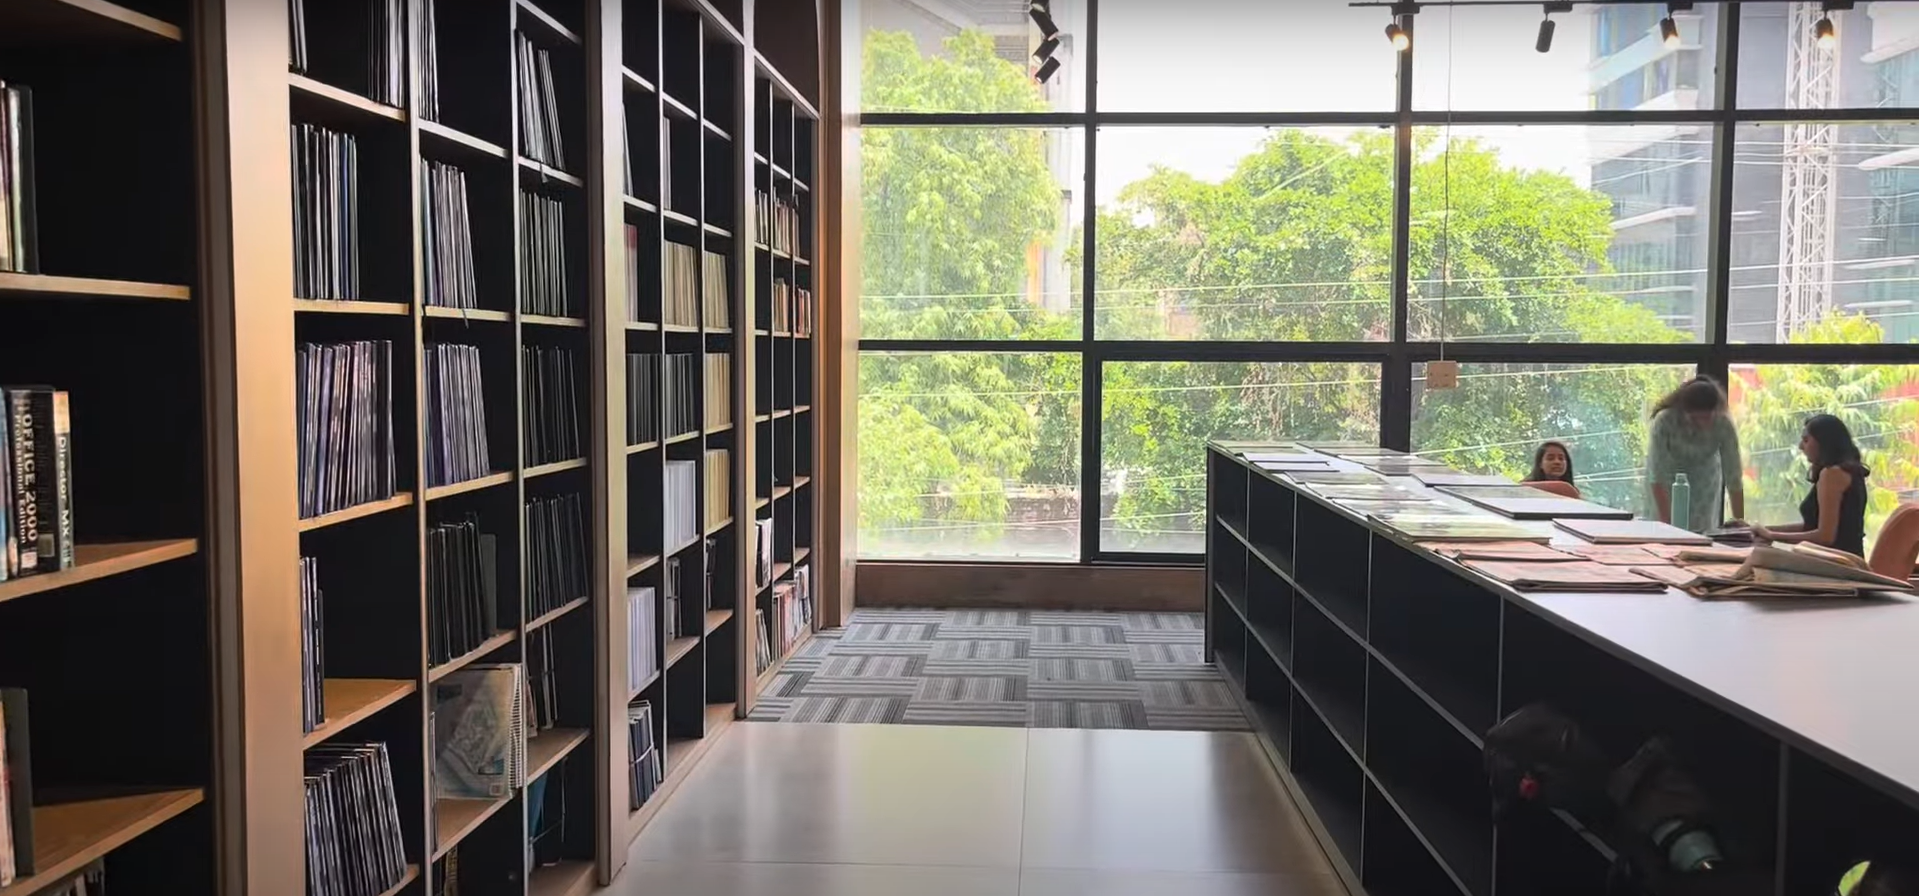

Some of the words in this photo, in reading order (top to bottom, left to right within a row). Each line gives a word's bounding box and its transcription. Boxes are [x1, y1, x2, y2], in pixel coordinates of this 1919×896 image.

[14, 414, 25, 494] Professional
[22, 413, 36, 486] OFFICE
[58, 436, 68, 500] Director
[19, 499, 27, 544] Edition
[25, 491, 39, 541] 2000
[60, 509, 71, 536] MX
